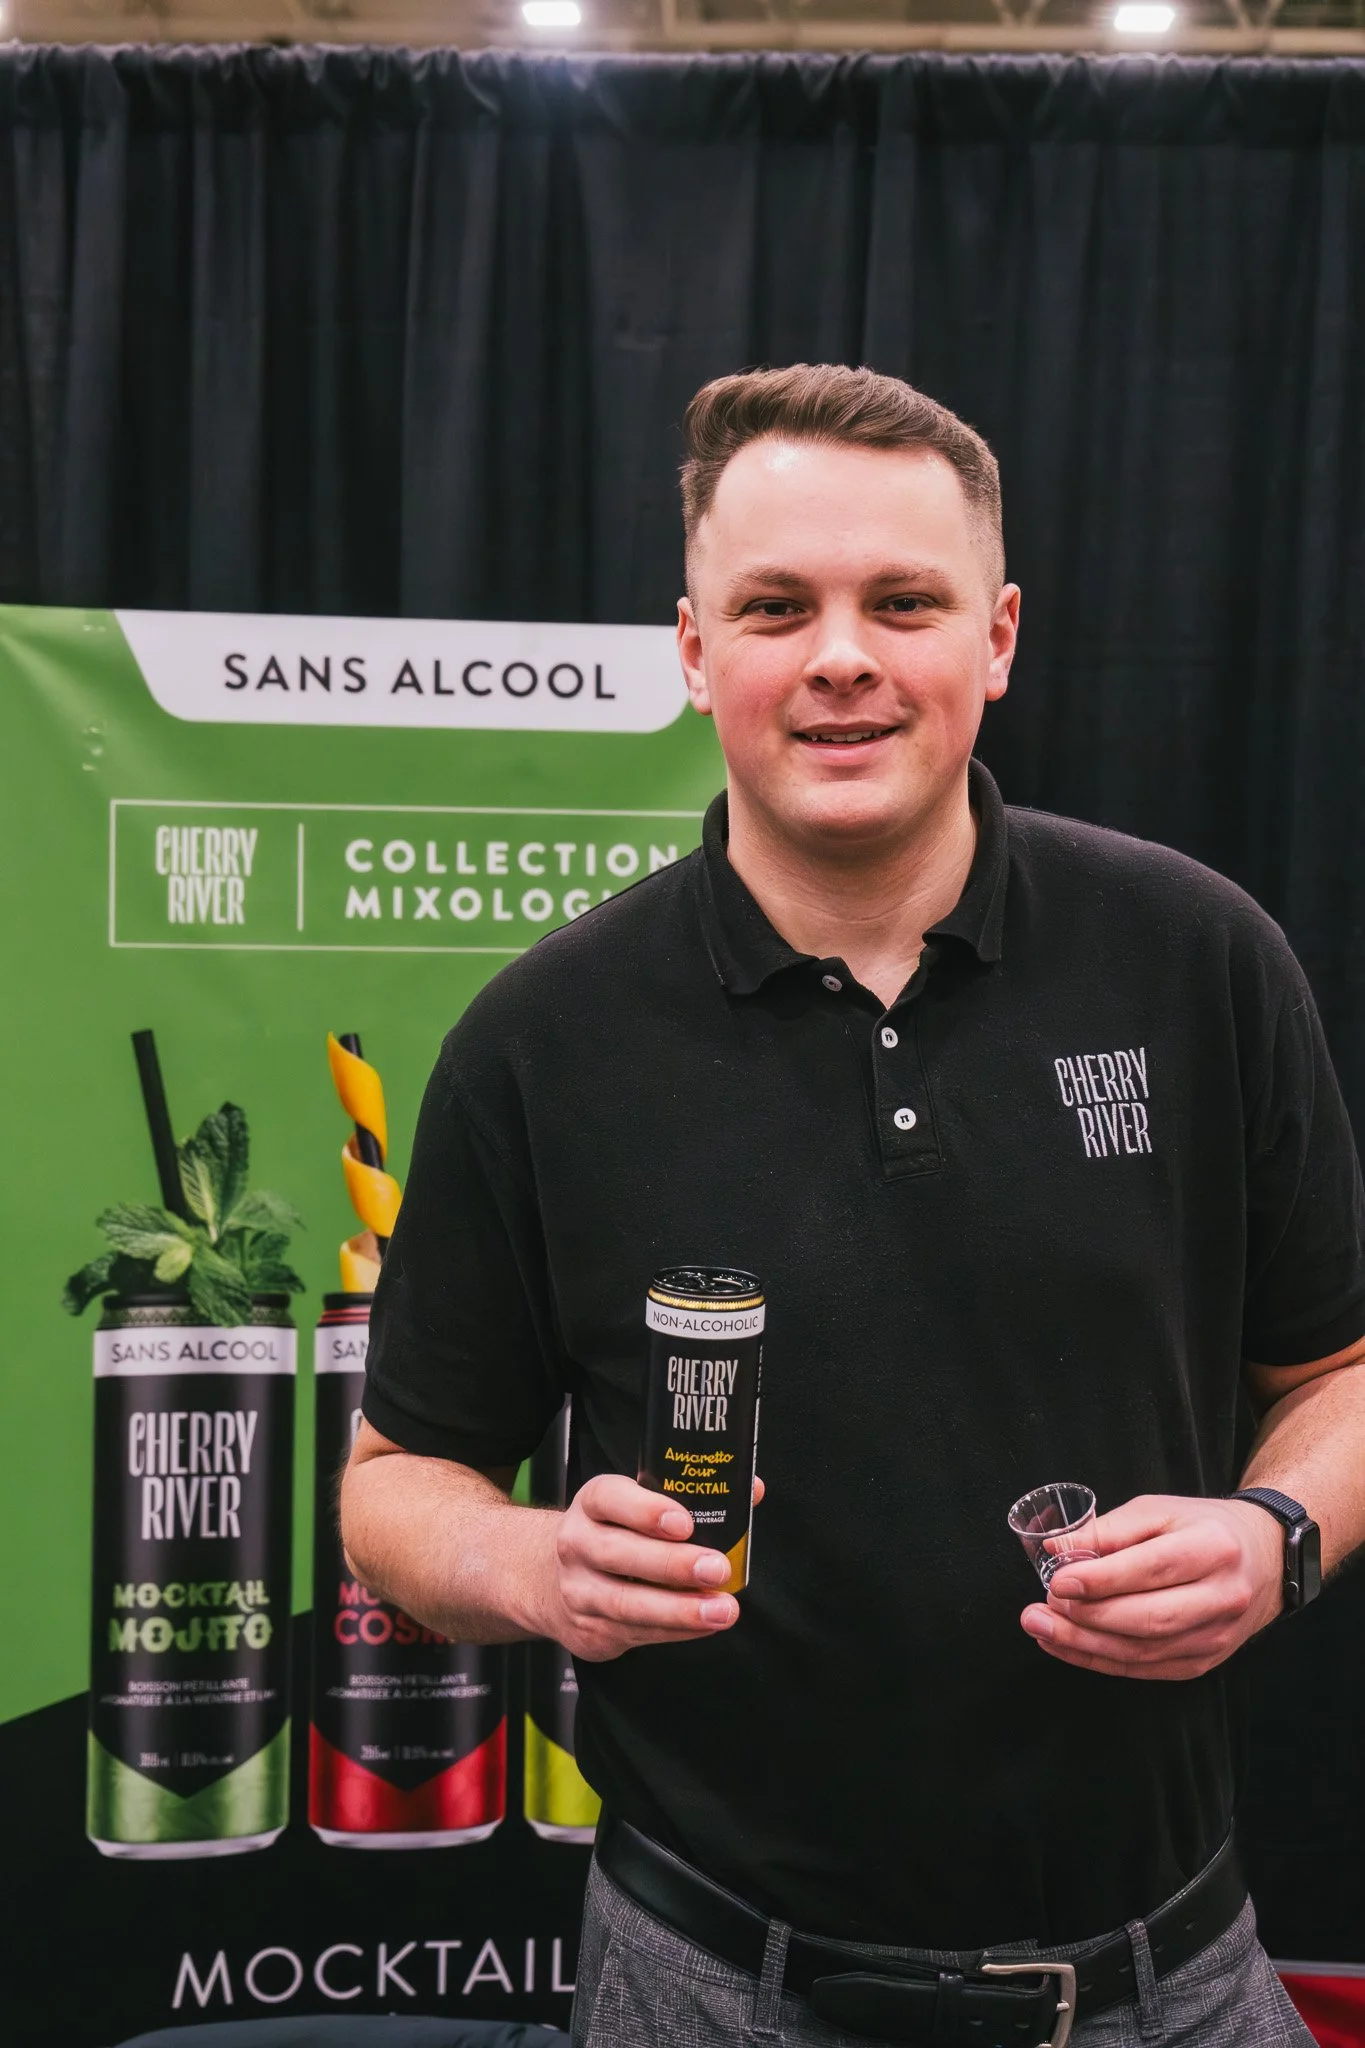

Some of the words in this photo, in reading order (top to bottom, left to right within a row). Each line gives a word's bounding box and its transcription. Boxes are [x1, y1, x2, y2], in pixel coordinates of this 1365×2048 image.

[223, 653, 367, 694] SANS
[391, 659, 616, 699] ALCOOL
[155, 825, 258, 877] CHERRY
[345, 839, 678, 877] COLLECTION
[168, 874, 245, 926] RIVER
[1054, 1047, 1149, 1107] CHERRY
[1077, 1102, 1152, 1157] RIVER
[653, 1311, 759, 1332] NON-ALCOHOLIC
[111, 1341, 171, 1363] SANS
[178, 1340, 279, 1362] ALCOOL
[667, 1356, 738, 1395] CHERRY
[673, 1393, 728, 1431] RIVER
[128, 1410, 258, 1476] CHERRY
[664, 1447, 734, 1464] Amaretto
[663, 1478, 730, 1494] MOCKTAIL
[681, 1464, 717, 1477] Sour
[141, 1475, 241, 1540] RIVER
[113, 1580, 270, 1612] MOCKTAIL
[109, 1613, 273, 1653] MOJITO
